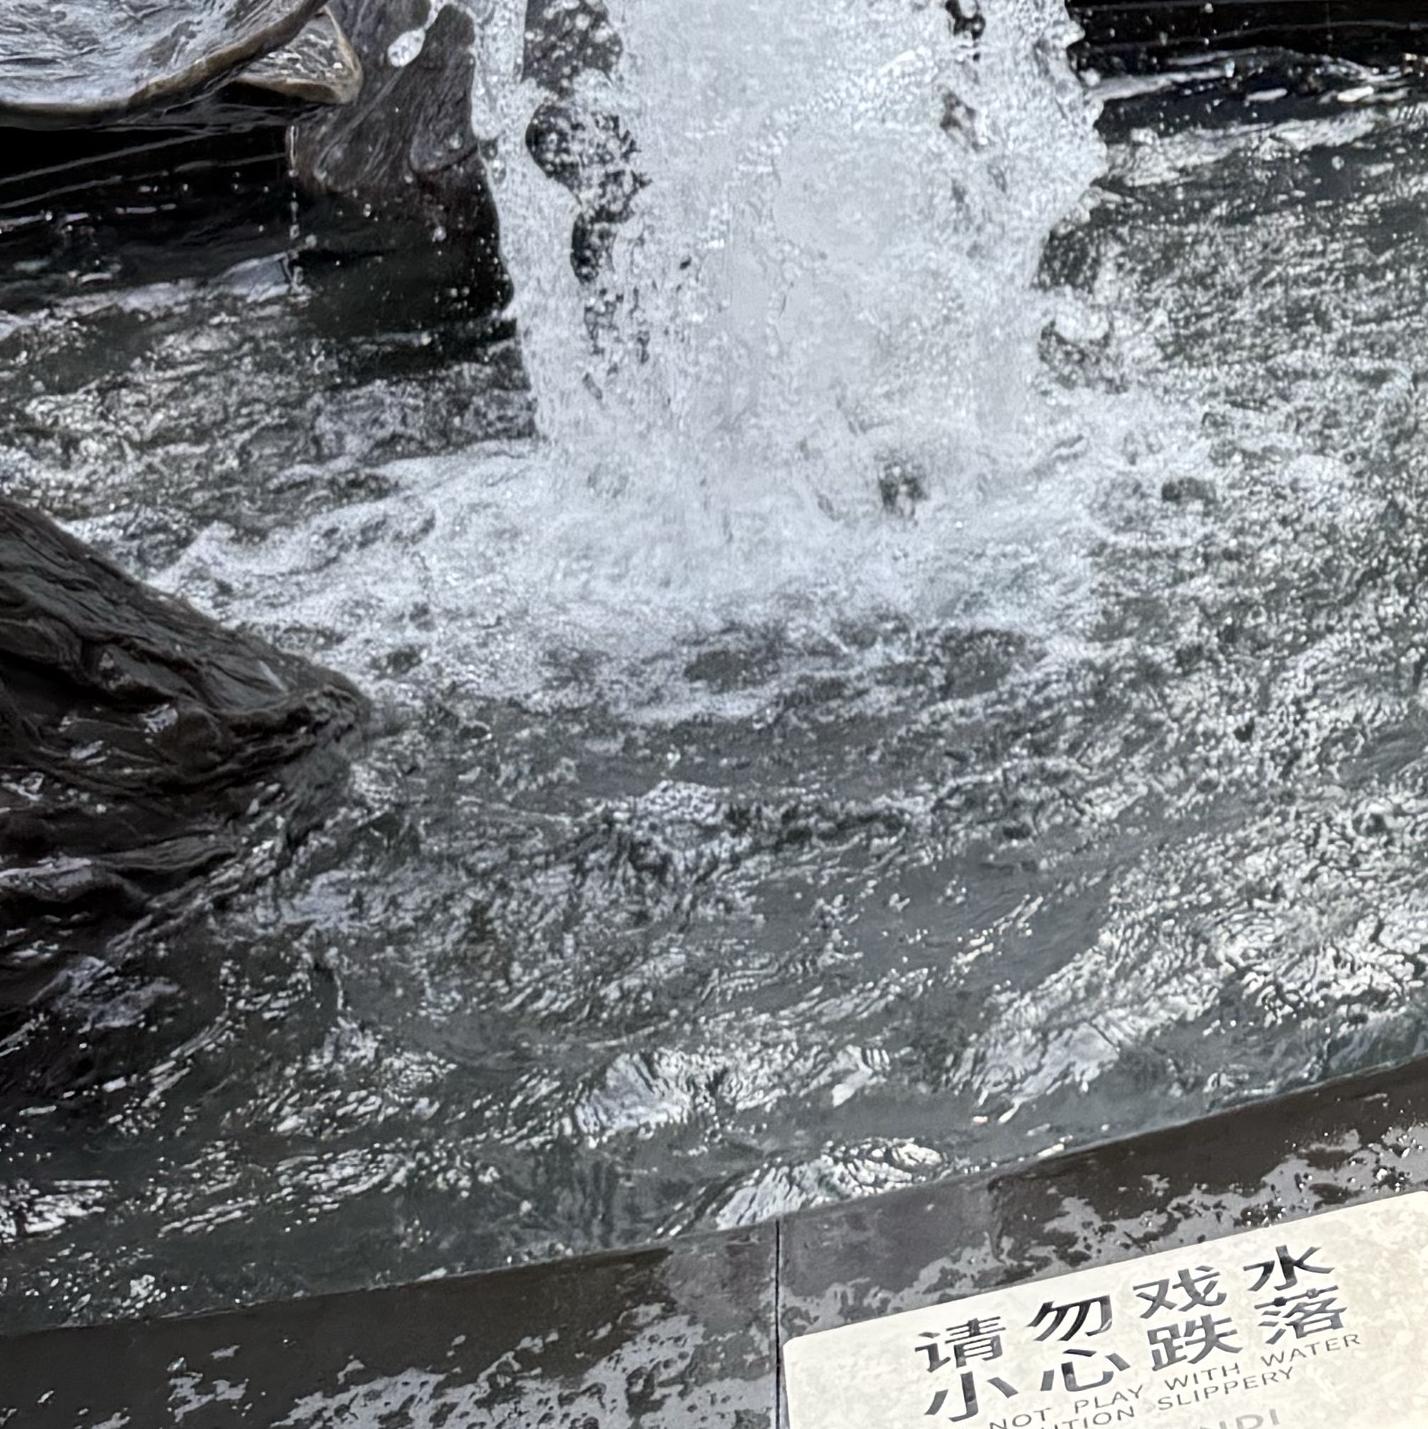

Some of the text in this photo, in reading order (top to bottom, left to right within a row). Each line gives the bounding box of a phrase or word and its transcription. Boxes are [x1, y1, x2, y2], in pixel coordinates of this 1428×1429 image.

[914, 1245, 1335, 1373] 请勿戏水
[924, 1285, 1348, 1423] 小心跌落
[1074, 1384, 1144, 1414] PLAY
[1164, 1362, 1241, 1391] WITH
[1260, 1333, 1362, 1367] WATER
[1157, 1365, 1294, 1411] SLIPPERY
